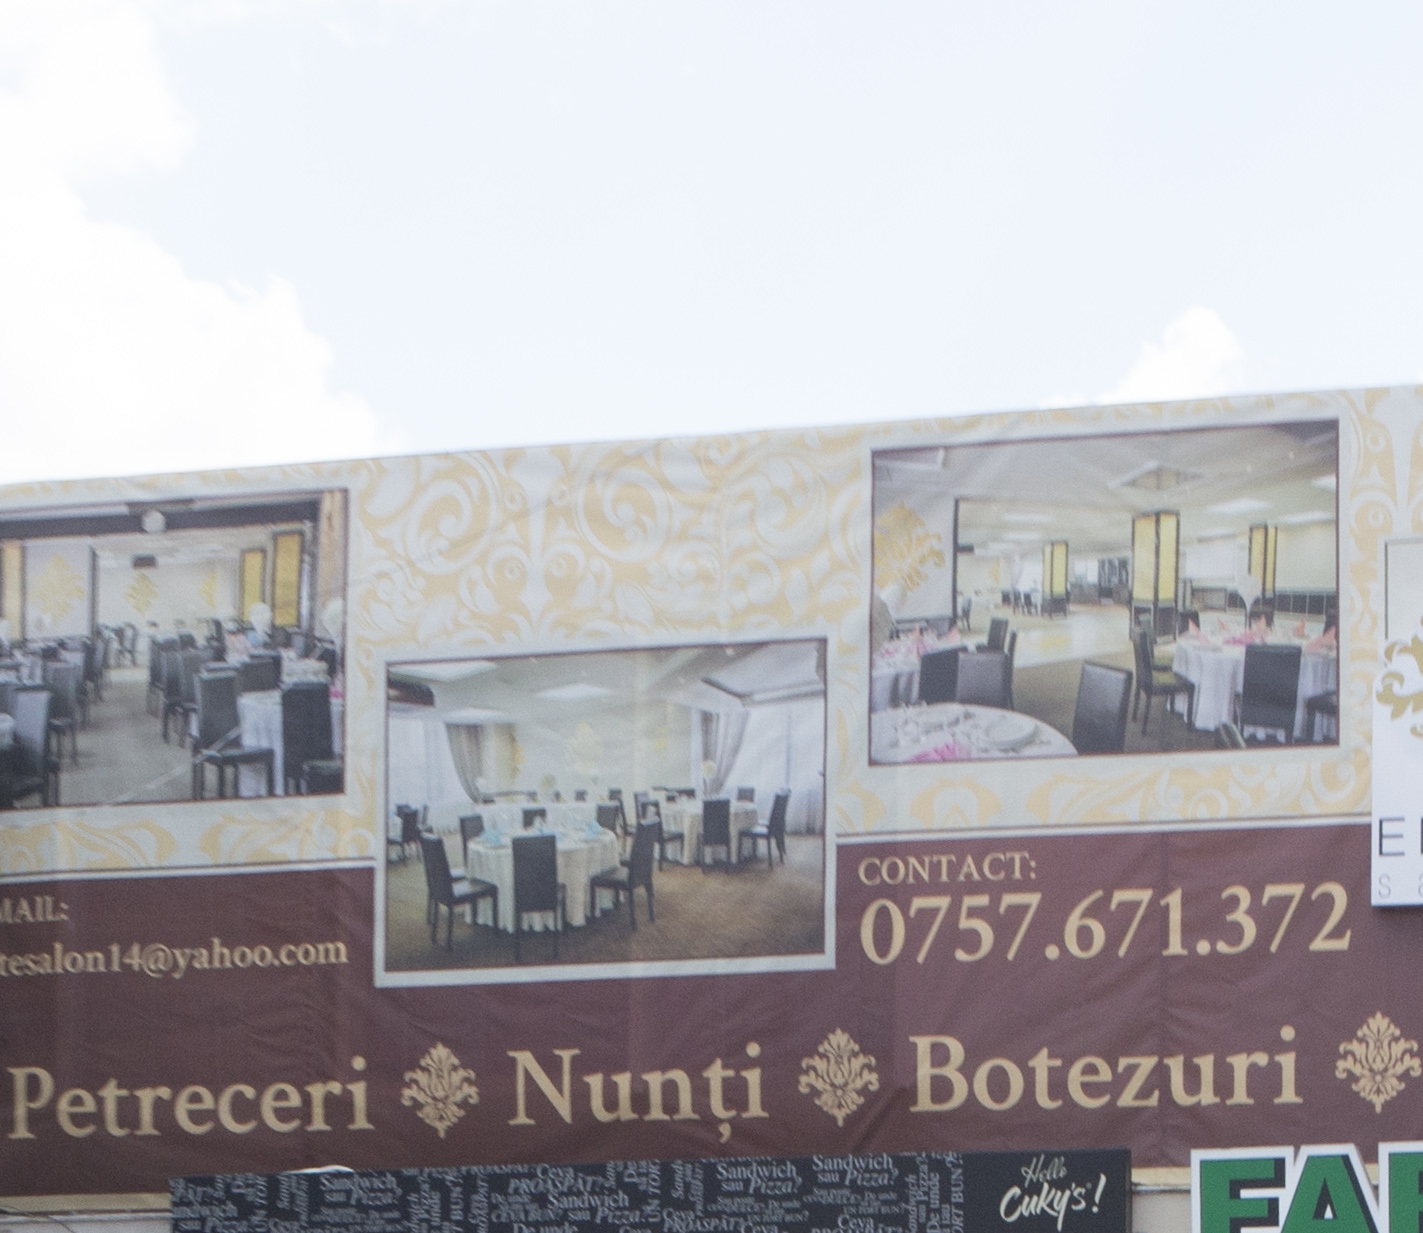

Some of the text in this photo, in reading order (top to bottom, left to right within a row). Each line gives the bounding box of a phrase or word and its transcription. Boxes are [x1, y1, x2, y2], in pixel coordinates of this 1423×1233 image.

[858, 852, 1036, 886] CONTACT:
[859, 881, 1352, 966] 0757.671.372
[6, 1056, 375, 1142] Petreceri
[507, 1042, 769, 1143] Nunți
[908, 1025, 1304, 1114] Botezuri
